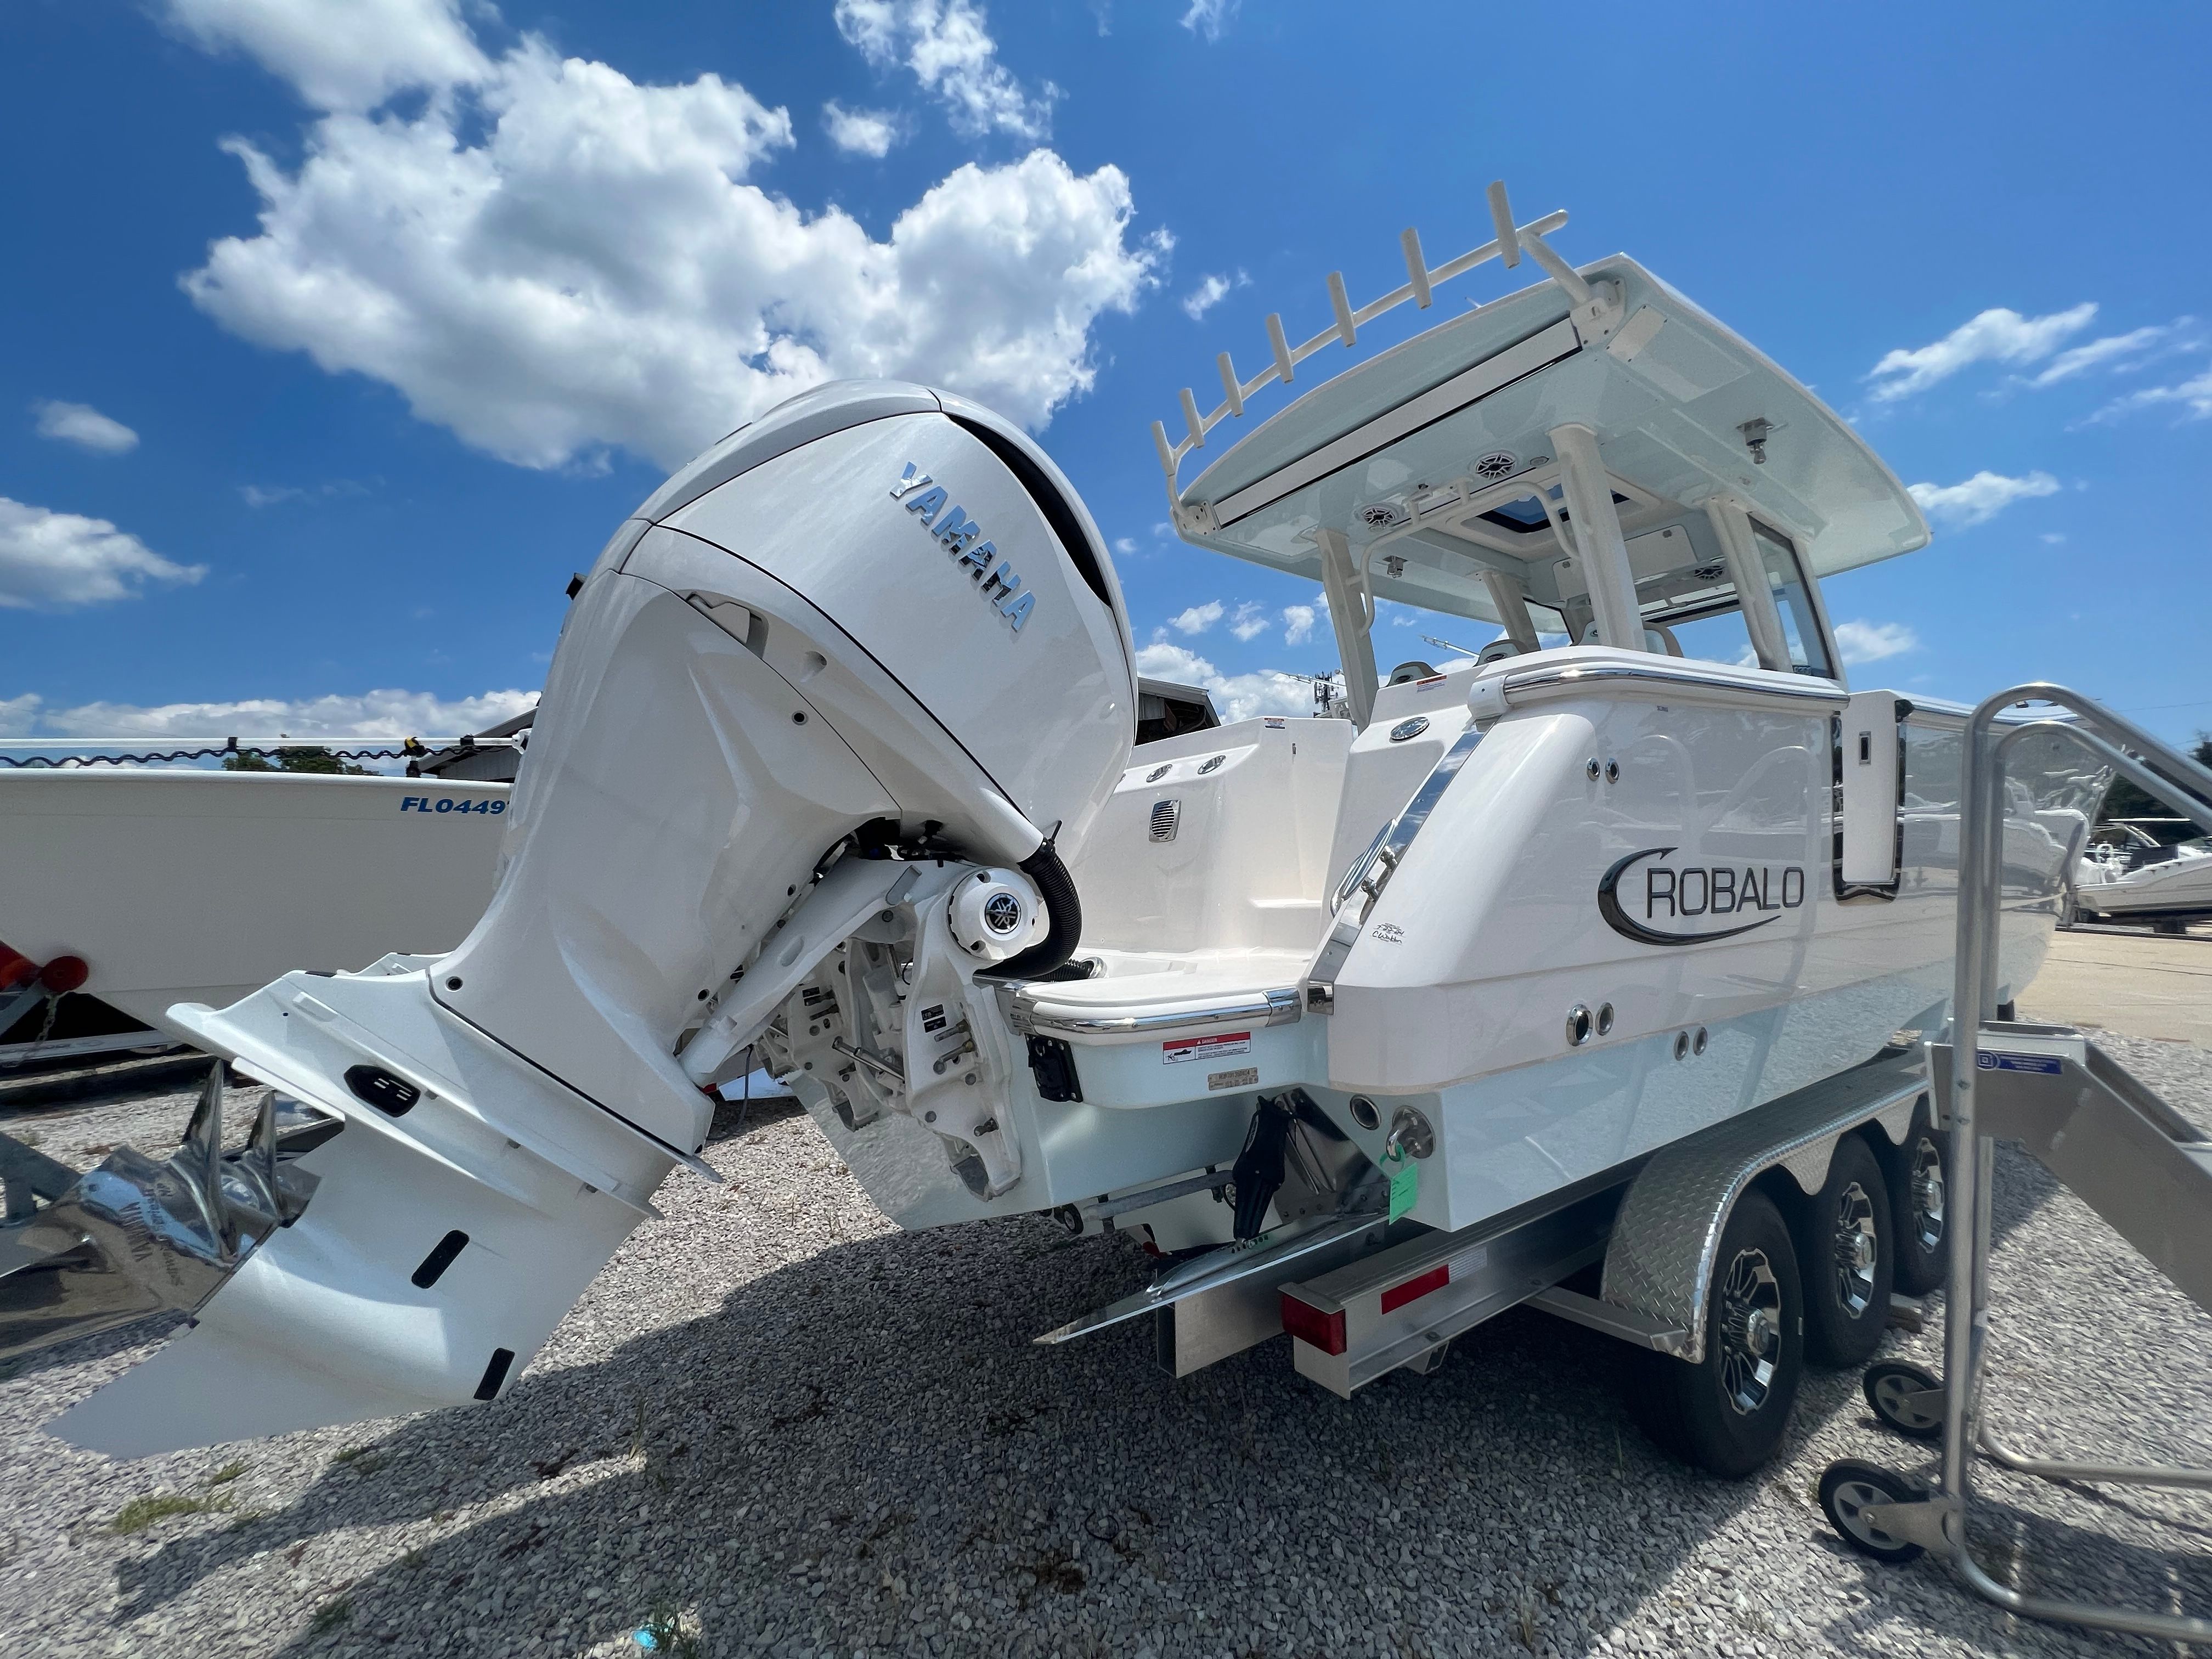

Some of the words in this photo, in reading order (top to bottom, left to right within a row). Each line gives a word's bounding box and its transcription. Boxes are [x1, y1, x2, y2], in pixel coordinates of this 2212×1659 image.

[889, 461, 1036, 633] YAMAHA
[400, 797, 510, 815] FL0449
[1647, 866, 1805, 918] ROBALO
